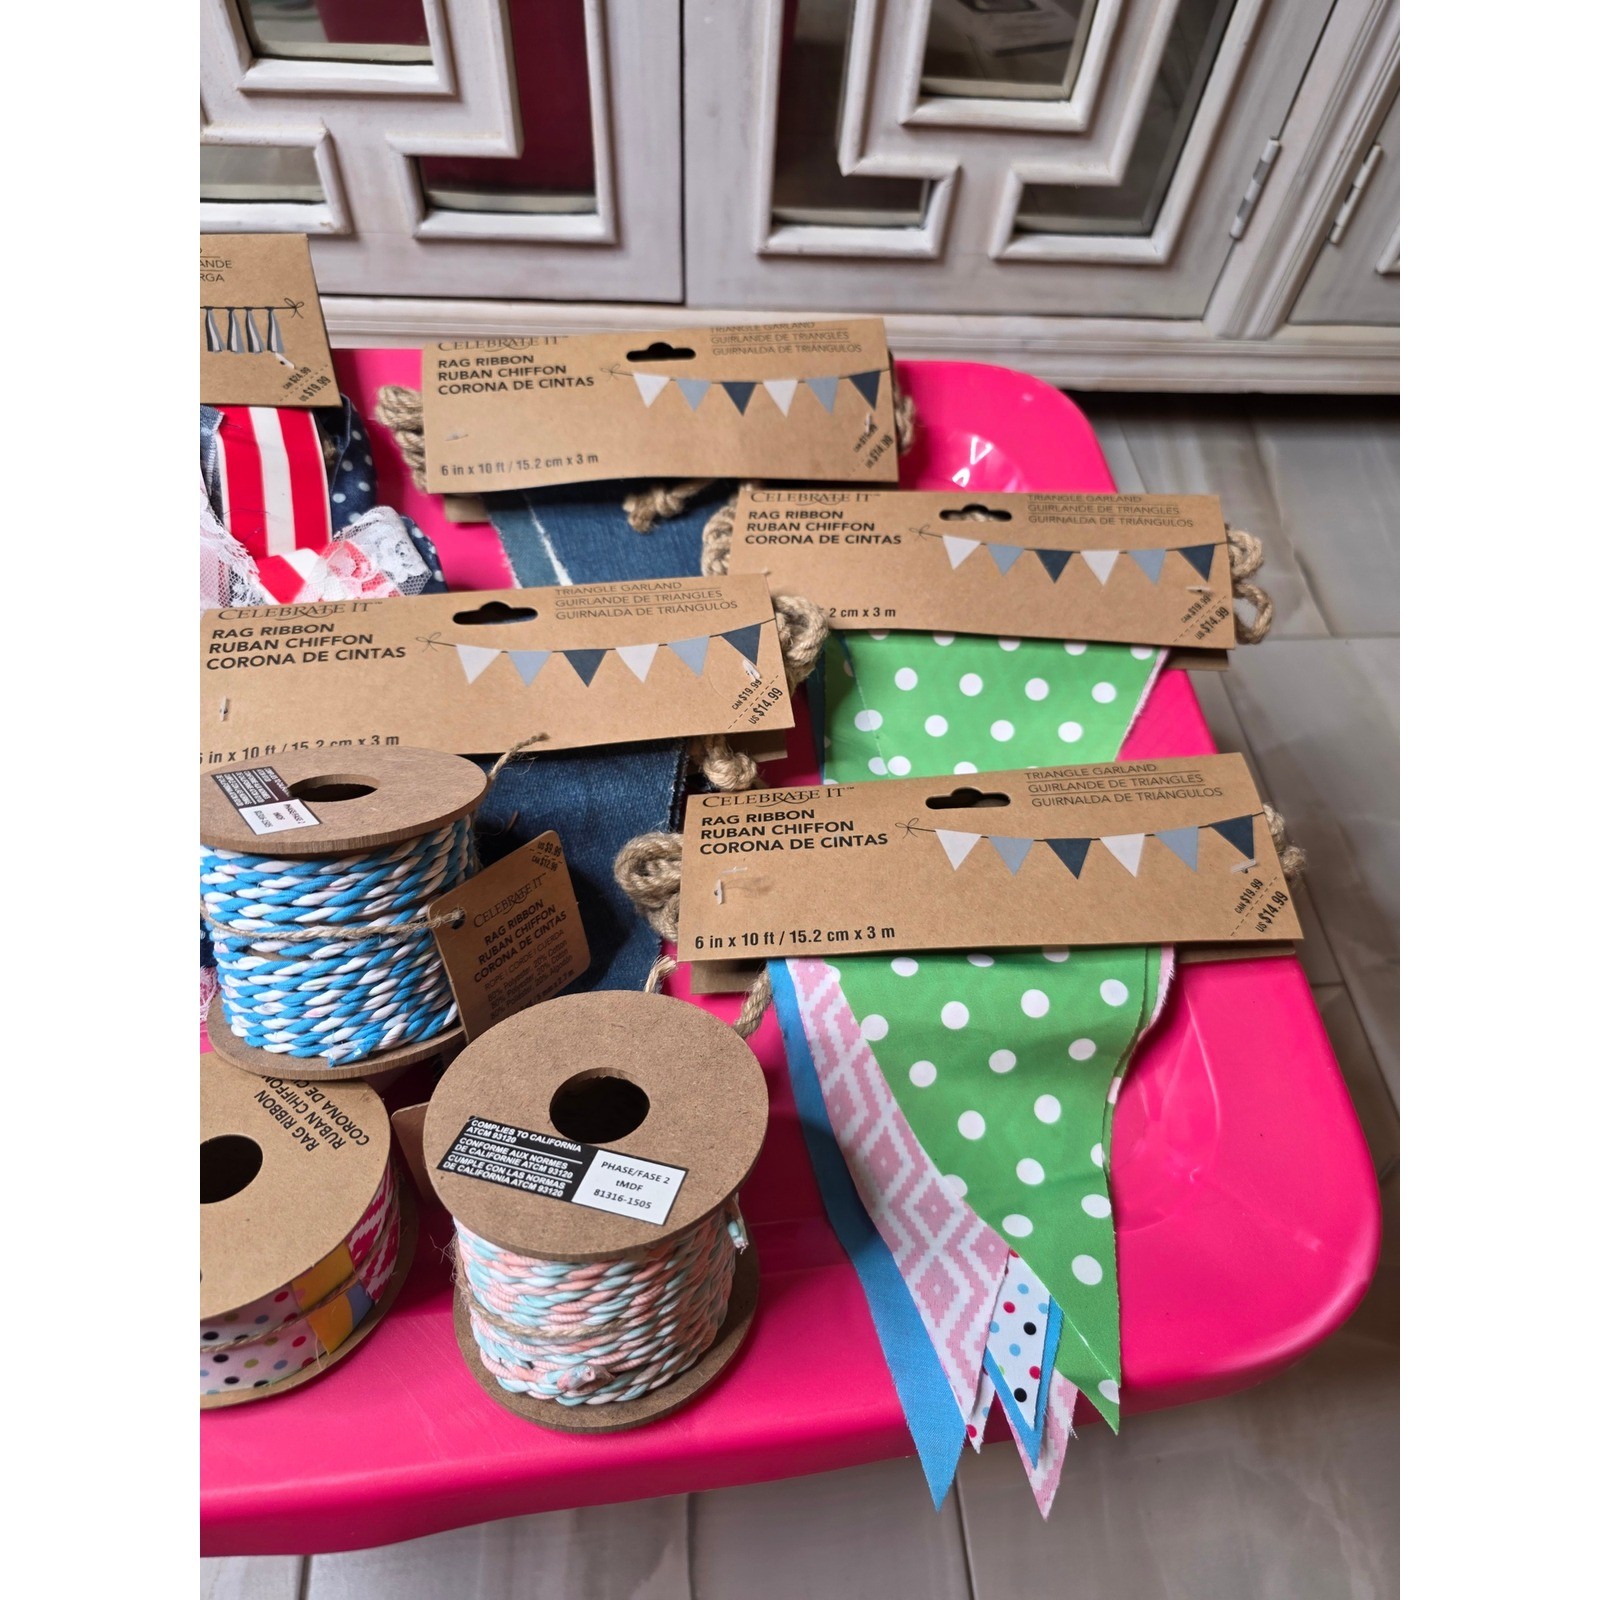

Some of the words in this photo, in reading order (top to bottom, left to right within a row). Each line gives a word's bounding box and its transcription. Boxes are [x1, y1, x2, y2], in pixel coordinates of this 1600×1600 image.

[711, 334, 772, 344] GUIRLANDE
[775, 333, 789, 341] DE
[793, 331, 849, 341] TRIANGLES
[712, 347, 776, 356] GUIRNALDA
[779, 346, 792, 354] DE
[438, 359, 470, 368] RAG
[476, 355, 534, 366] RIBBON
[438, 369, 492, 381] RUBAN
[498, 365, 567, 378] CHIFFON
[438, 382, 508, 395] CORONA
[513, 380, 534, 390] DE
[539, 377, 594, 389] CINTAS
[441, 465, 448, 476] 6
[453, 464, 464, 475] in
[479, 463, 492, 474] 10
[496, 461, 505, 473] ft
[516, 458, 542, 470] 15.2
[546, 457, 562, 468] cm
[567, 457, 573, 465] x
[577, 454, 583, 464] 3
[588, 454, 598, 463] m
[751, 493, 850, 505] CELEBRATE
[748, 511, 780, 519] RAG
[786, 511, 843, 519] RIBBON
[1028, 505, 1093, 513] GUIRLANDE
[1098, 506, 1112, 514] DE
[1116, 506, 1179, 515] TRIANGLES
[747, 523, 800, 531] RUBAN
[806, 523, 875, 531] CHIFFON
[1028, 516, 1096, 525] GUIRNALDA
[1100, 517, 1116, 525] DE
[745, 535, 813, 544] CORONA
[819, 535, 839, 544] DE
[845, 535, 902, 544] CINTAS
[555, 585, 617, 596] TRIANGLE
[621, 581, 682, 592] GARLAND
[555, 596, 629, 608] GUIRLANDE
[633, 594, 650, 604] DE
[654, 590, 722, 602] TRIANGLES
[1188, 594, 1212, 616] $19.99
[218, 604, 345, 621] CELEBRATE
[555, 608, 633, 620] GUIRNALDA
[636, 607, 653, 616] DE
[840, 609, 858, 618] cm
[862, 609, 869, 617] x
[873, 607, 880, 618] 3
[885, 609, 896, 617] m
[1200, 606, 1229, 634] $14.99
[212, 628, 253, 639] RAG
[260, 623, 335, 636] RIBBON
[209, 640, 279, 654] RUBAN
[285, 634, 373, 648] CHIFFON
[206, 653, 295, 670] CORONA
[303, 651, 328, 663] DE
[335, 647, 406, 661] CINTAS
[731, 699, 743, 711] CAN
[738, 678, 763, 702] $19.99
[753, 686, 784, 717] $14.99
[748, 714, 760, 725] US
[209, 751, 222, 764] in
[228, 752, 236, 762] x
[242, 747, 259, 760] 10
[1024, 768, 1089, 780] TRIANGLE
[1093, 764, 1157, 776] GARLAND
[1028, 780, 1105, 793] GUIRLANDE
[1109, 778, 1127, 788] DE
[1131, 773, 1204, 786] TRIANGLES
[702, 789, 820, 807] CELEBRATE
[1031, 794, 1111, 807] GUIRNALDA
[1114, 792, 1133, 803] DE
[702, 815, 740, 826] RAG
[746, 809, 815, 823] RIBBON
[701, 826, 766, 840] RUBAN
[772, 820, 854, 835] CHIFFON
[700, 839, 784, 855] CORONA
[790, 838, 814, 850] DE
[821, 833, 888, 849] CINTAS
[474, 883, 532, 928] CELEBRATE
[1234, 901, 1246, 914] CAN
[1241, 878, 1264, 905] $19.99
[1258, 890, 1289, 925] $14.99
[484, 925, 506, 946] RAG
[508, 899, 544, 929] RIBBON
[1255, 922, 1268, 933] US
[478, 934, 513, 964] RUBAN
[515, 905, 556, 938] CHIFFON
[695, 936, 704, 949] 6
[710, 935, 723, 948] in
[728, 937, 736, 947] x
[742, 933, 758, 946] 10
[764, 932, 774, 945] ft
[790, 929, 821, 944] 15.2
[827, 929, 849, 941] cm
[854, 930, 862, 939] x
[868, 926, 876, 939] 3
[882, 927, 895, 938] m
[474, 948, 518, 983] CORONA
[519, 935, 533, 951] DE
[534, 911, 567, 940] CINTAS
[305, 1086, 325, 1103] DE
[254, 1090, 297, 1130] RIBBON
[304, 1112, 347, 1150] RUBAN
[322, 1100, 370, 1146] CORONA
[292, 1126, 320, 1152] RAG
[467, 1126, 491, 1138] ATCM
[492, 1132, 517, 1144] 93120
[471, 1119, 515, 1135] COMPLIES
[517, 1130, 528, 1139] TO
[529, 1132, 582, 1152] CALIFORNIA
[455, 1144, 467, 1153] DE
[468, 1146, 521, 1167] CALIFORNIE
[522, 1158, 547, 1173] ATCM
[547, 1166, 574, 1179] 93120
[460, 1137, 509, 1154] CONFORME
[509, 1148, 529, 1160] AUX
[530, 1154, 568, 1170] NORMES
[443, 1161, 456, 1170] DE
[457, 1164, 510, 1185] CALIFORNIA
[510, 1177, 537, 1190] ATCM
[537, 1183, 563, 1197] 93120
[448, 1154, 486, 1170] CUMPLE
[486, 1163, 506, 1175] CON
[508, 1169, 526, 1179] LAS
[526, 1172, 566, 1189] NORMAS
[601, 1160, 662, 1183] PHASE/FASE
[663, 1176, 670, 1184] 2
[616, 1180, 644, 1192] tMDF
[593, 1188, 652, 1210] 81316-1505
